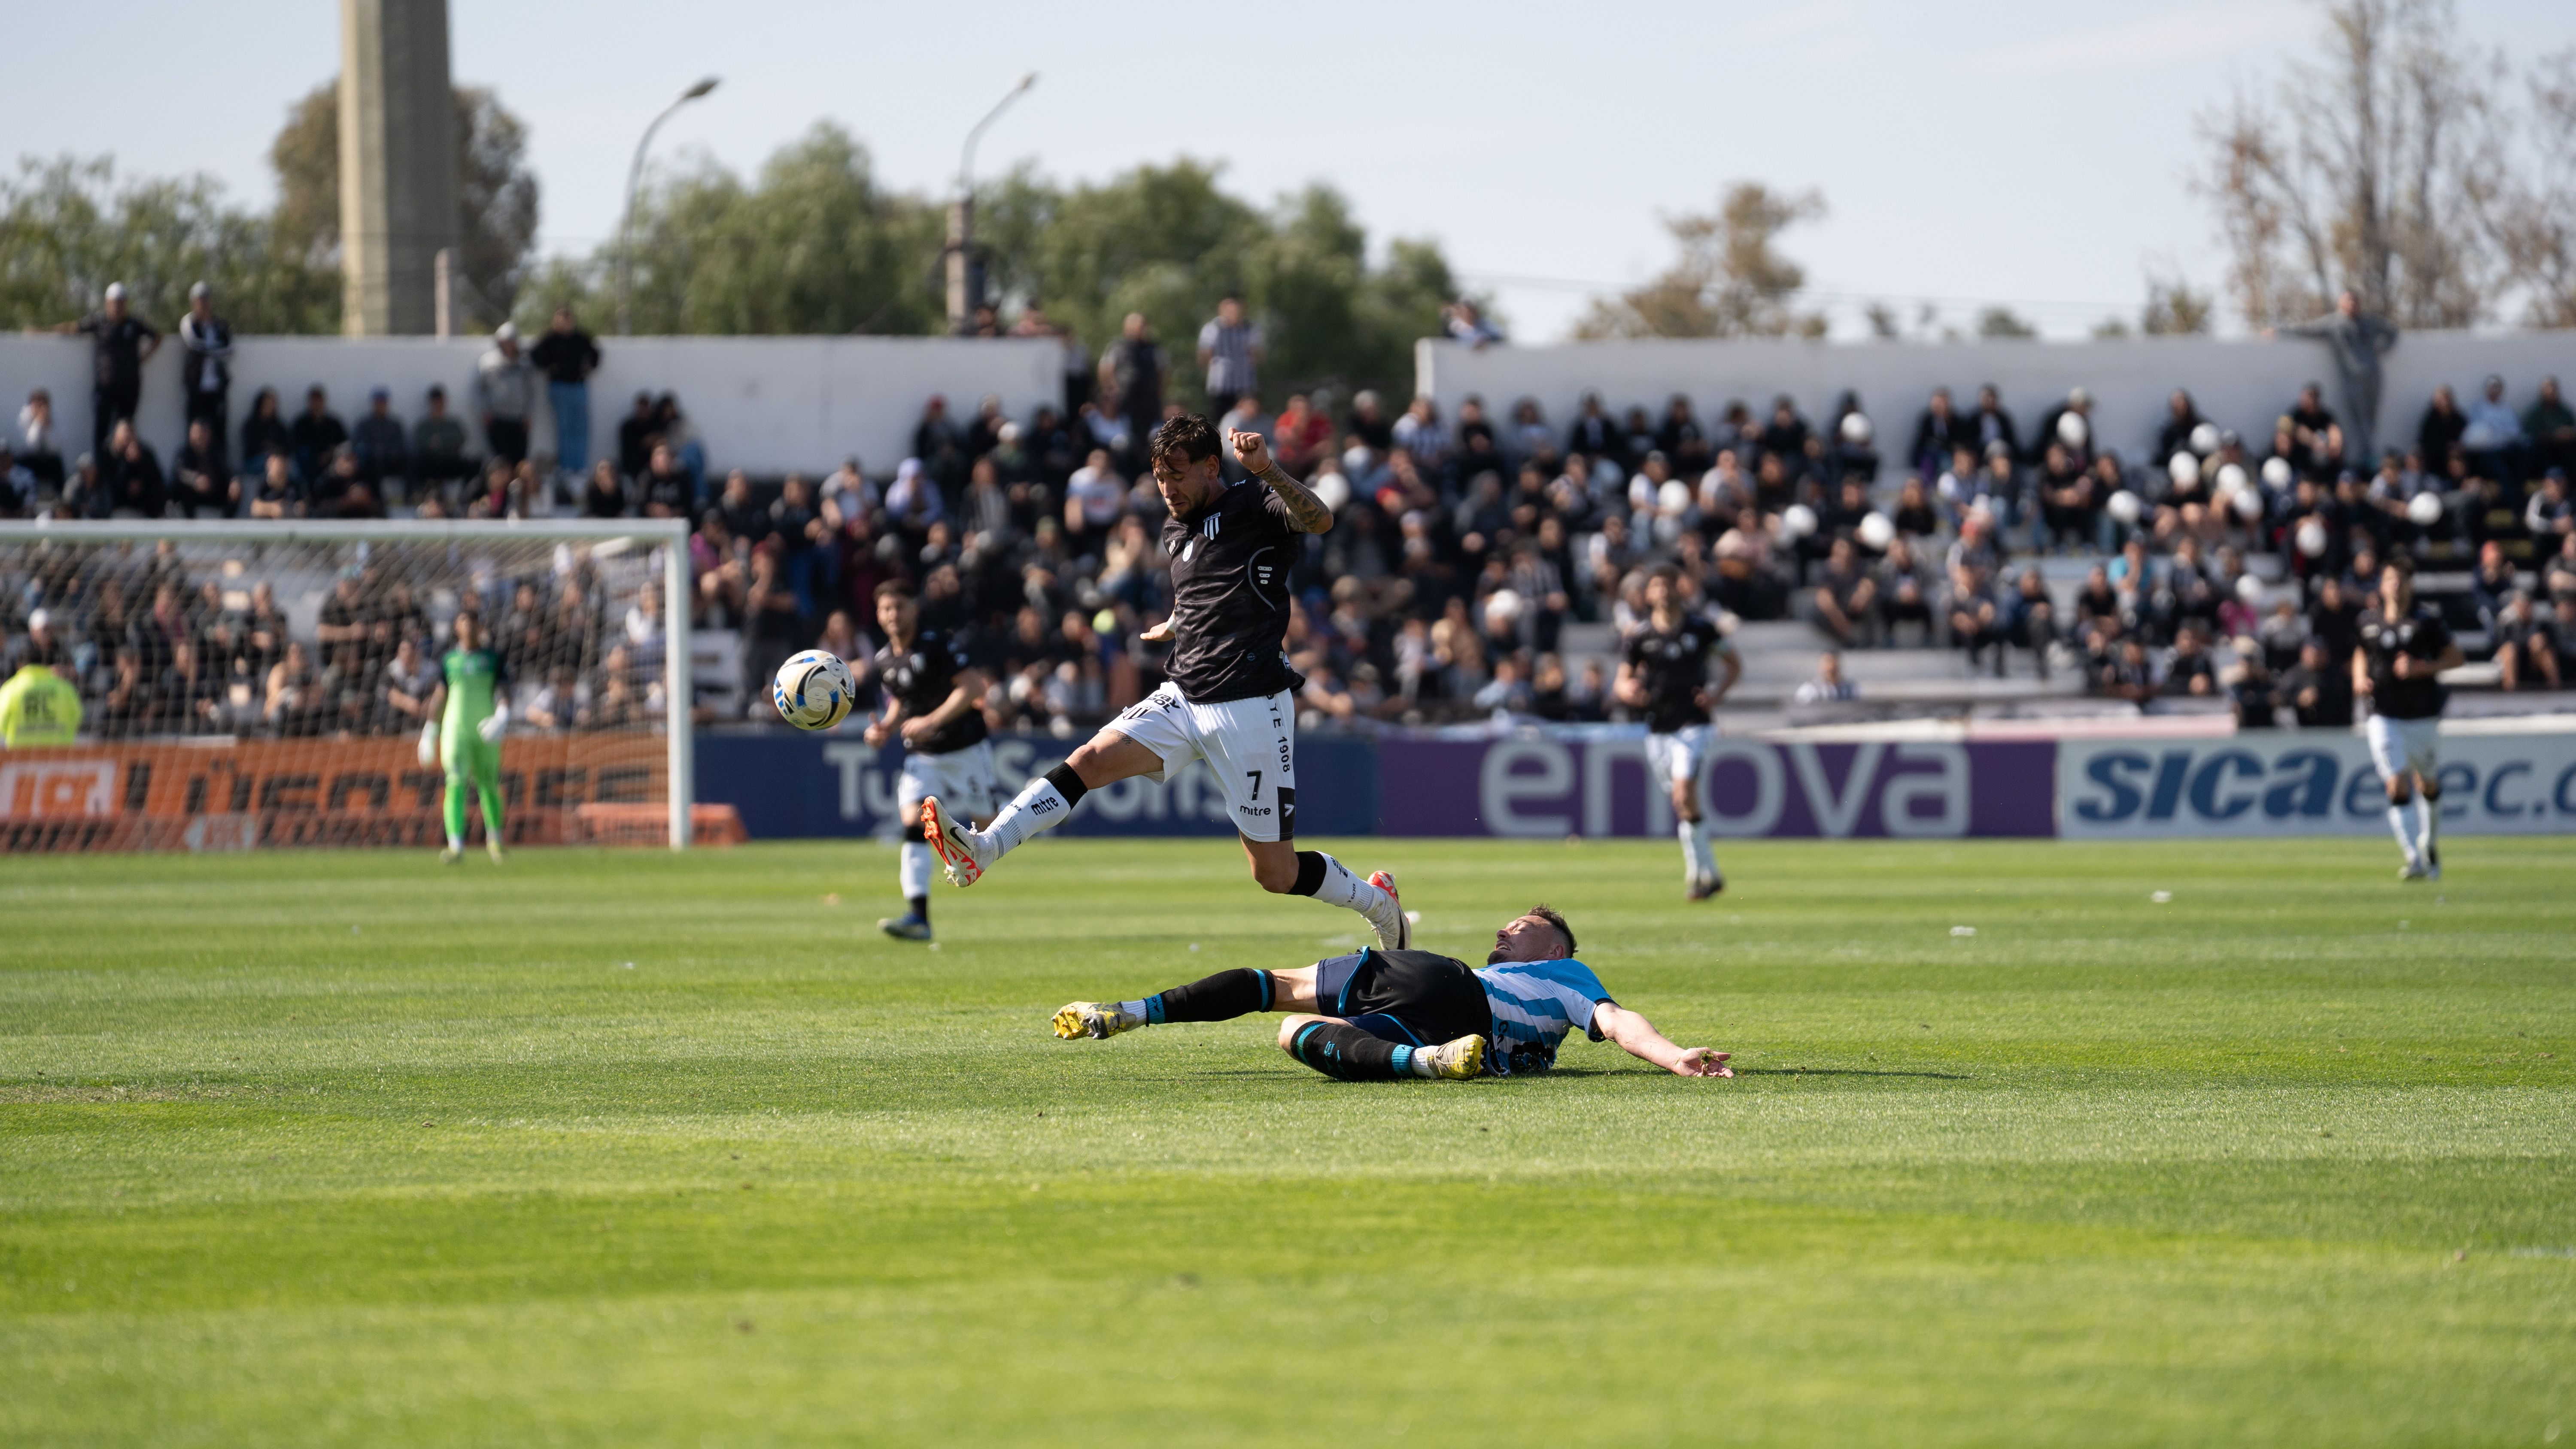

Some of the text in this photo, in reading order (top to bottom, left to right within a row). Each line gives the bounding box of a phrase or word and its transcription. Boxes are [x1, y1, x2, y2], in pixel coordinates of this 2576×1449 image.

[1278, 736, 1290, 773] 1908
[1246, 770, 1263, 801] 7
[1479, 737, 1971, 837] enova
[1031, 796, 1059, 816] mitre
[1239, 805, 1271, 816] mitre
